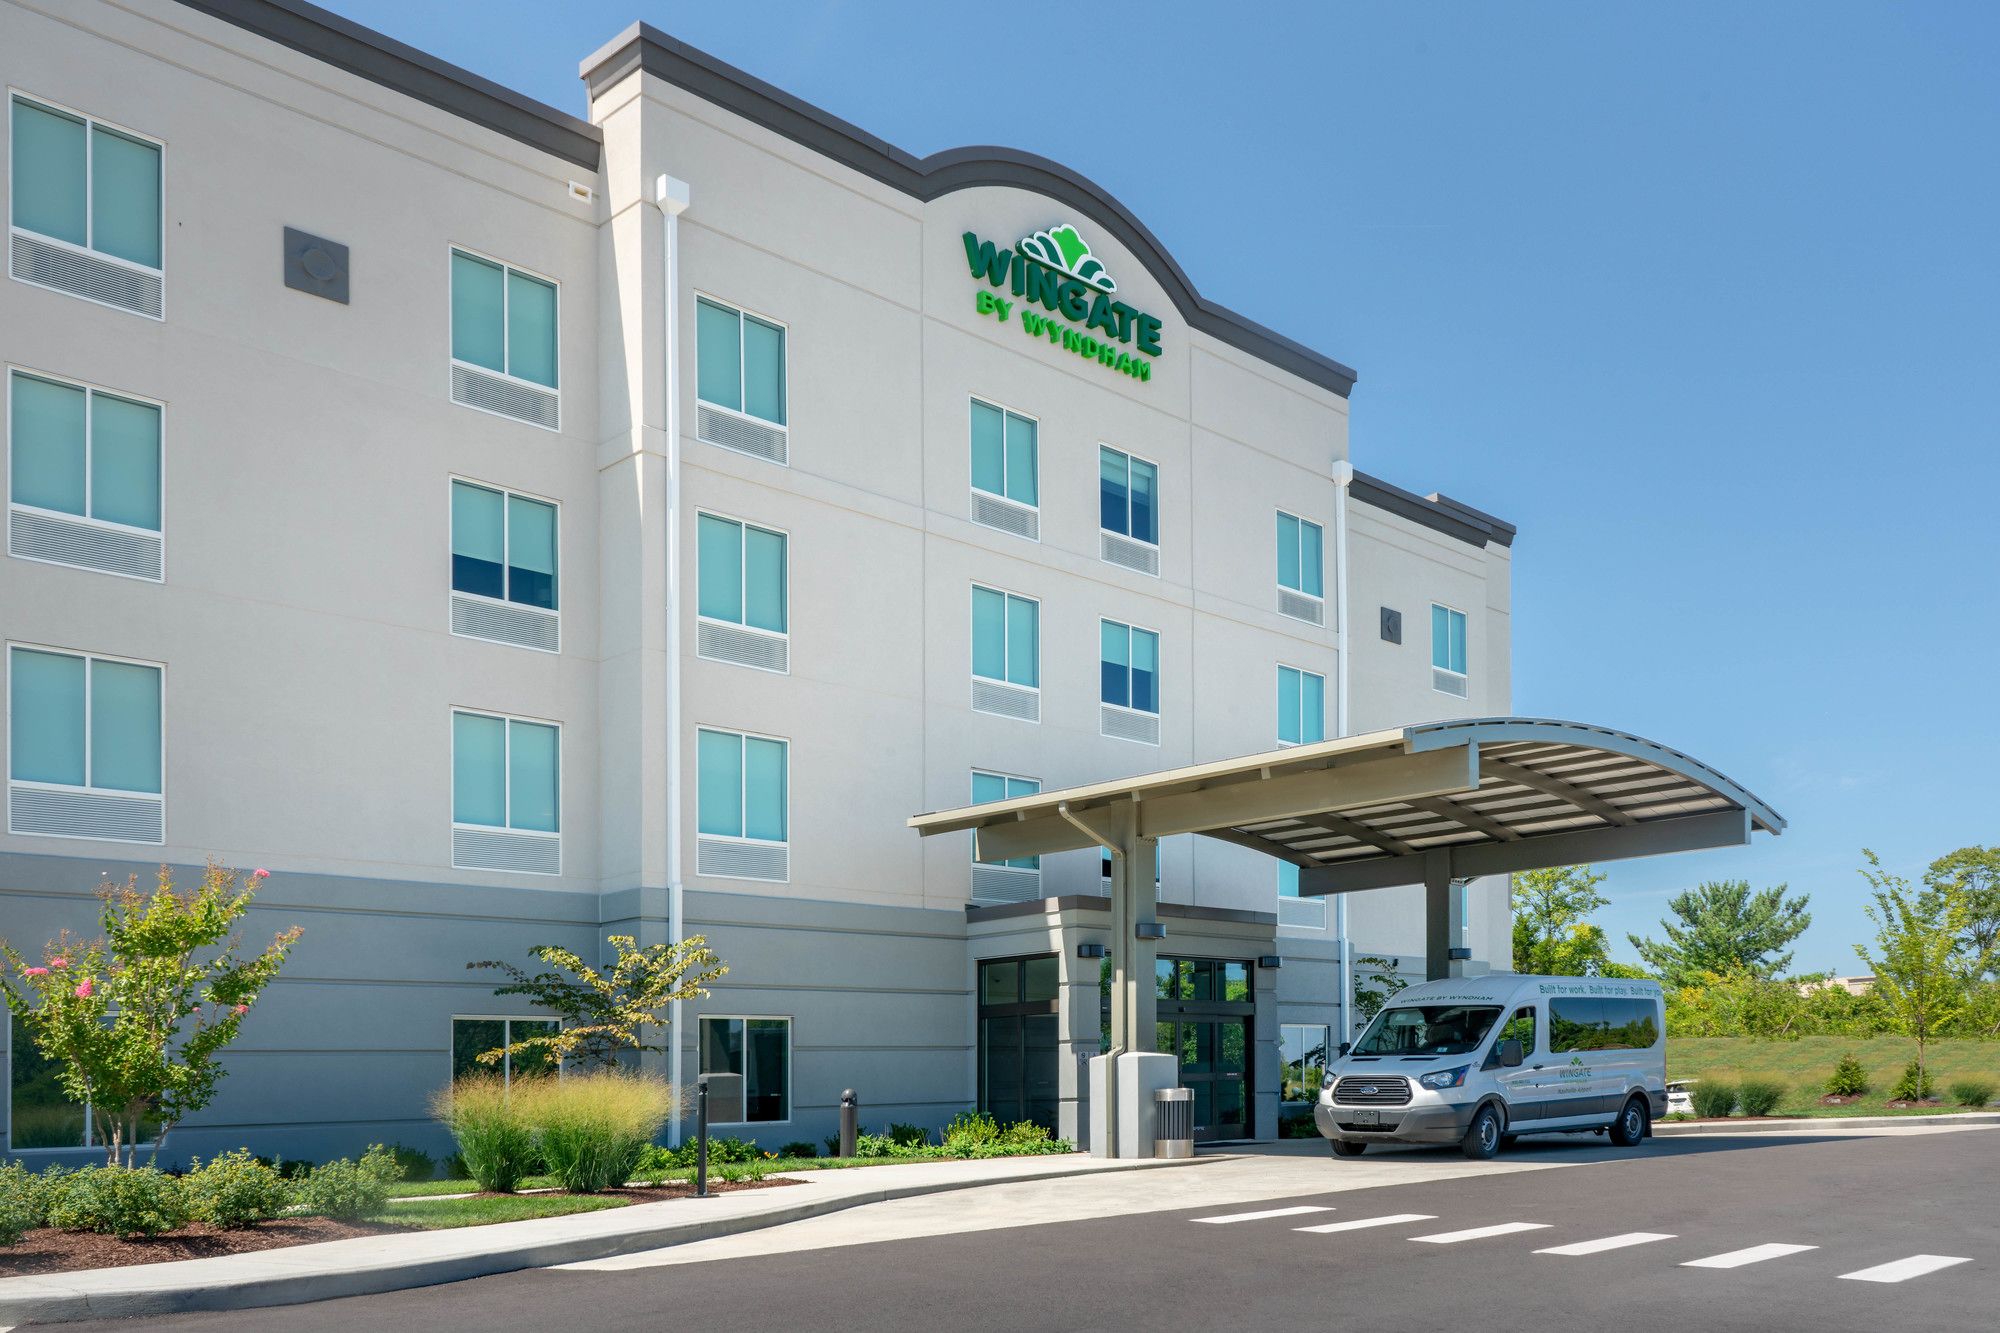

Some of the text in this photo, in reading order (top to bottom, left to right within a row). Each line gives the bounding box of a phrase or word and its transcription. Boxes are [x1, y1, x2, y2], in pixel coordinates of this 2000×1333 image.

[962, 231, 1162, 357] WINGATE
[976, 290, 1151, 382] BY WYNDHAM
[1539, 984, 1556, 994] Built
[1557, 985, 1567, 994] for
[1569, 985, 1586, 994] work.
[1589, 985, 1604, 995] Built
[1604, 986, 1614, 995] for
[1630, 986, 1644, 996] Built
[1400, 995, 1435, 1004] WINGATE
[1559, 1067, 1592, 1079] WINGATE
